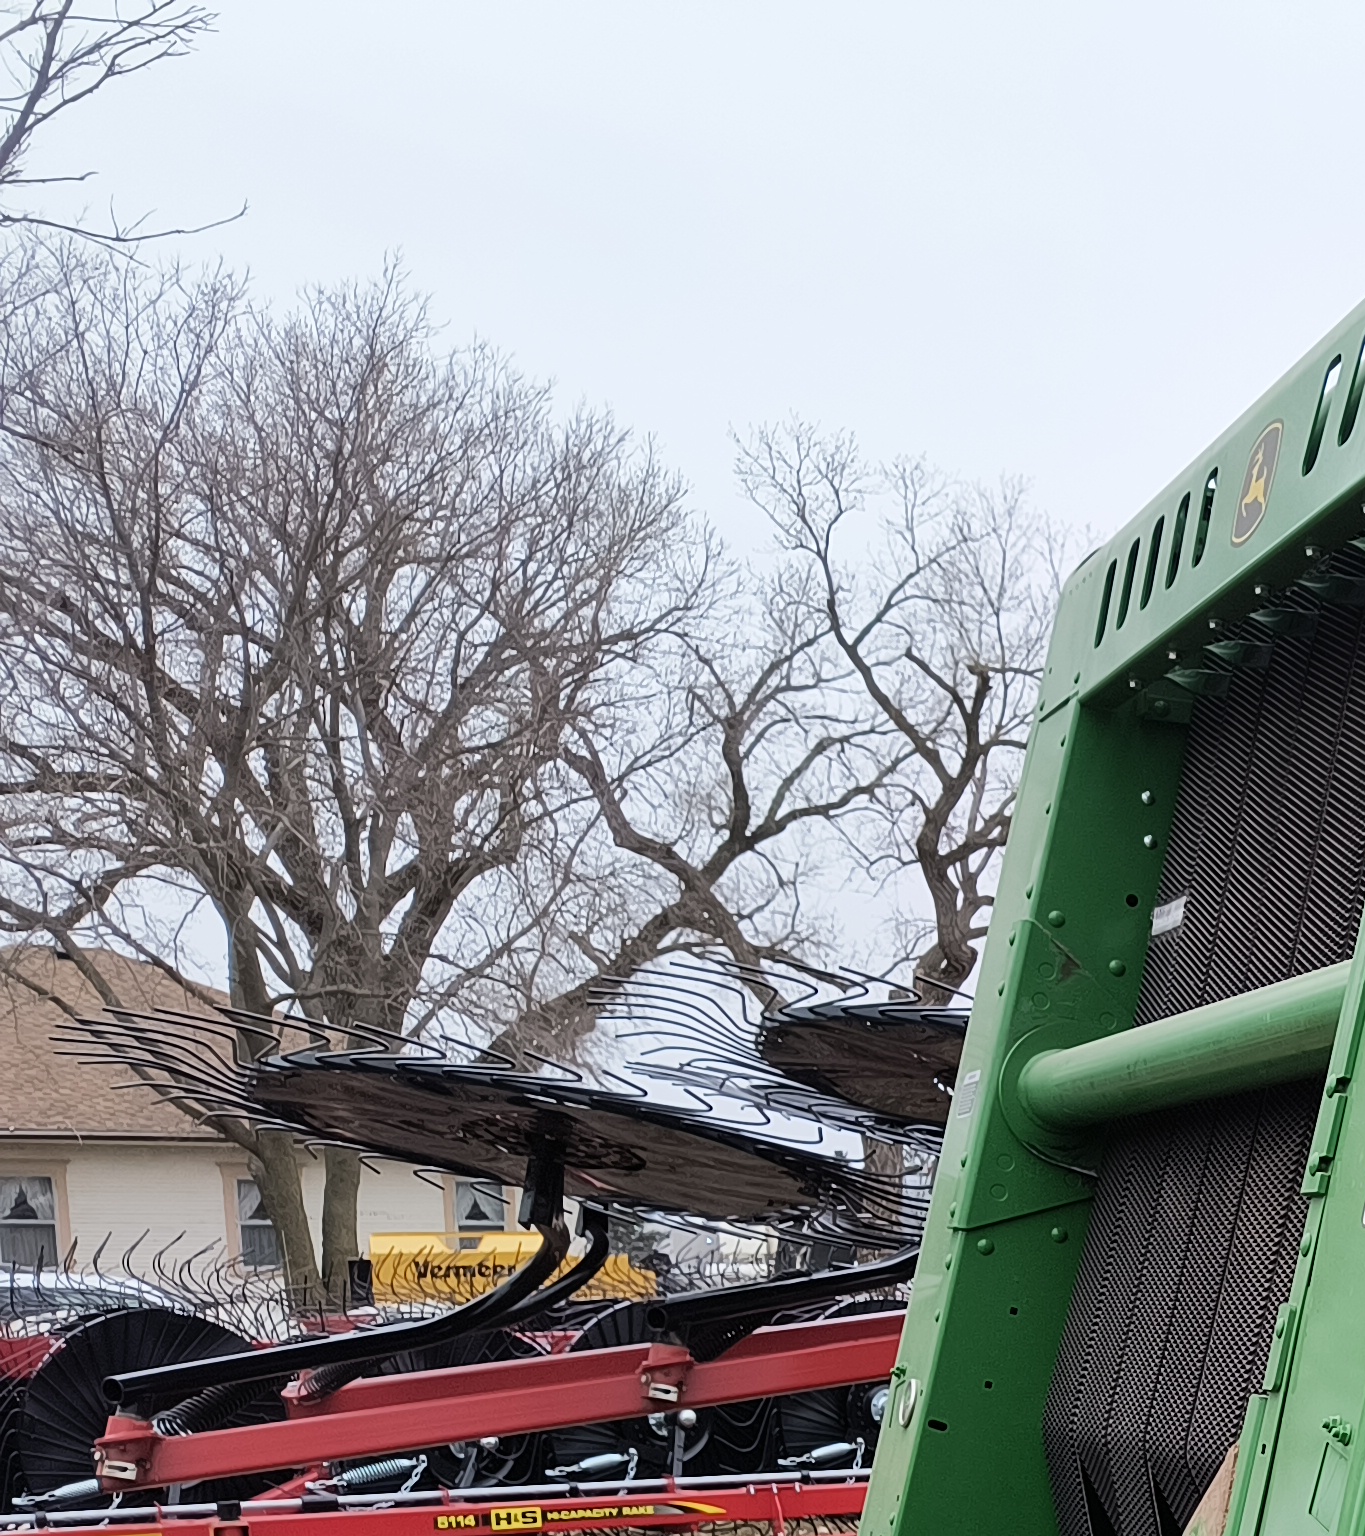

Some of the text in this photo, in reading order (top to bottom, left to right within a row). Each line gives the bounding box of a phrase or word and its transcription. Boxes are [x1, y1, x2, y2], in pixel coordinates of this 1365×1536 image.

[413, 1259, 517, 1279] Vermeer
[494, 1511, 539, 1526] H&S
[622, 1504, 655, 1516] RAKE
